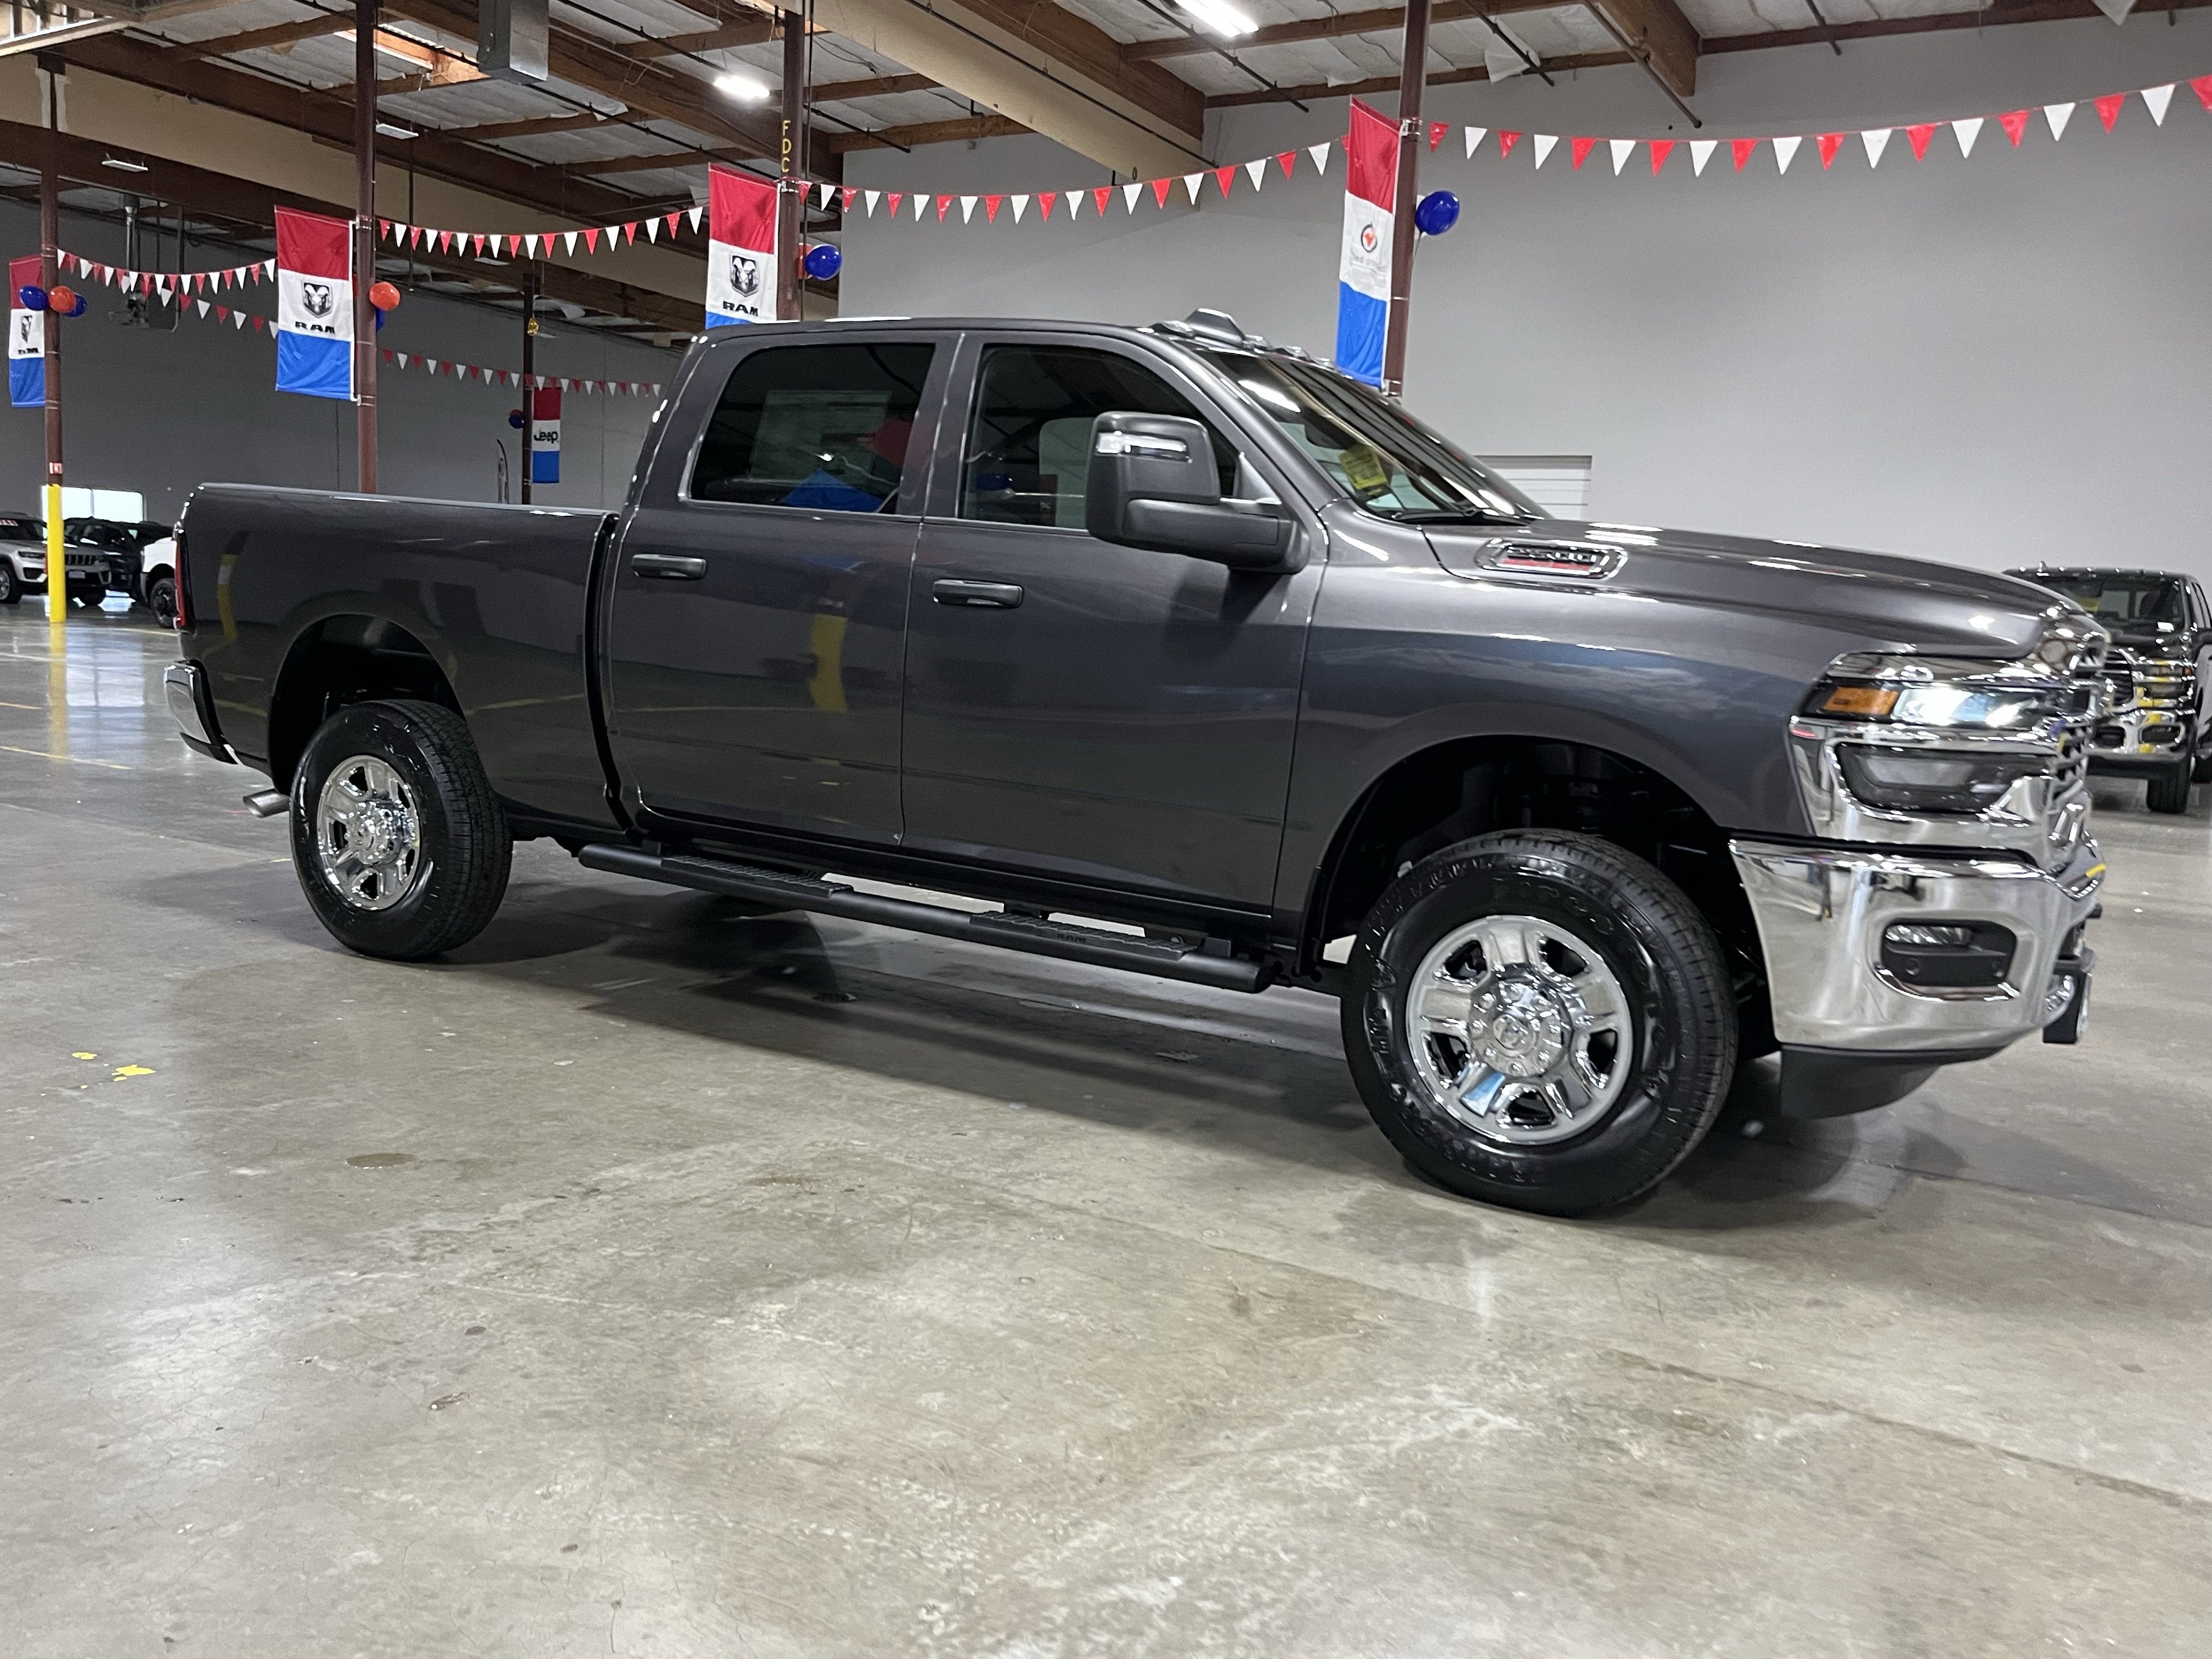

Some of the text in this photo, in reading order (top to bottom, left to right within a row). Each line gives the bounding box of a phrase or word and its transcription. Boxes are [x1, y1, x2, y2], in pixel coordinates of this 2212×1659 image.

[781, 120, 792, 173] FDC
[723, 300, 758, 317] RAM
[295, 321, 335, 335] RAM
[534, 429, 558, 444] Jeep
[1057, 933, 1086, 944] RAM
